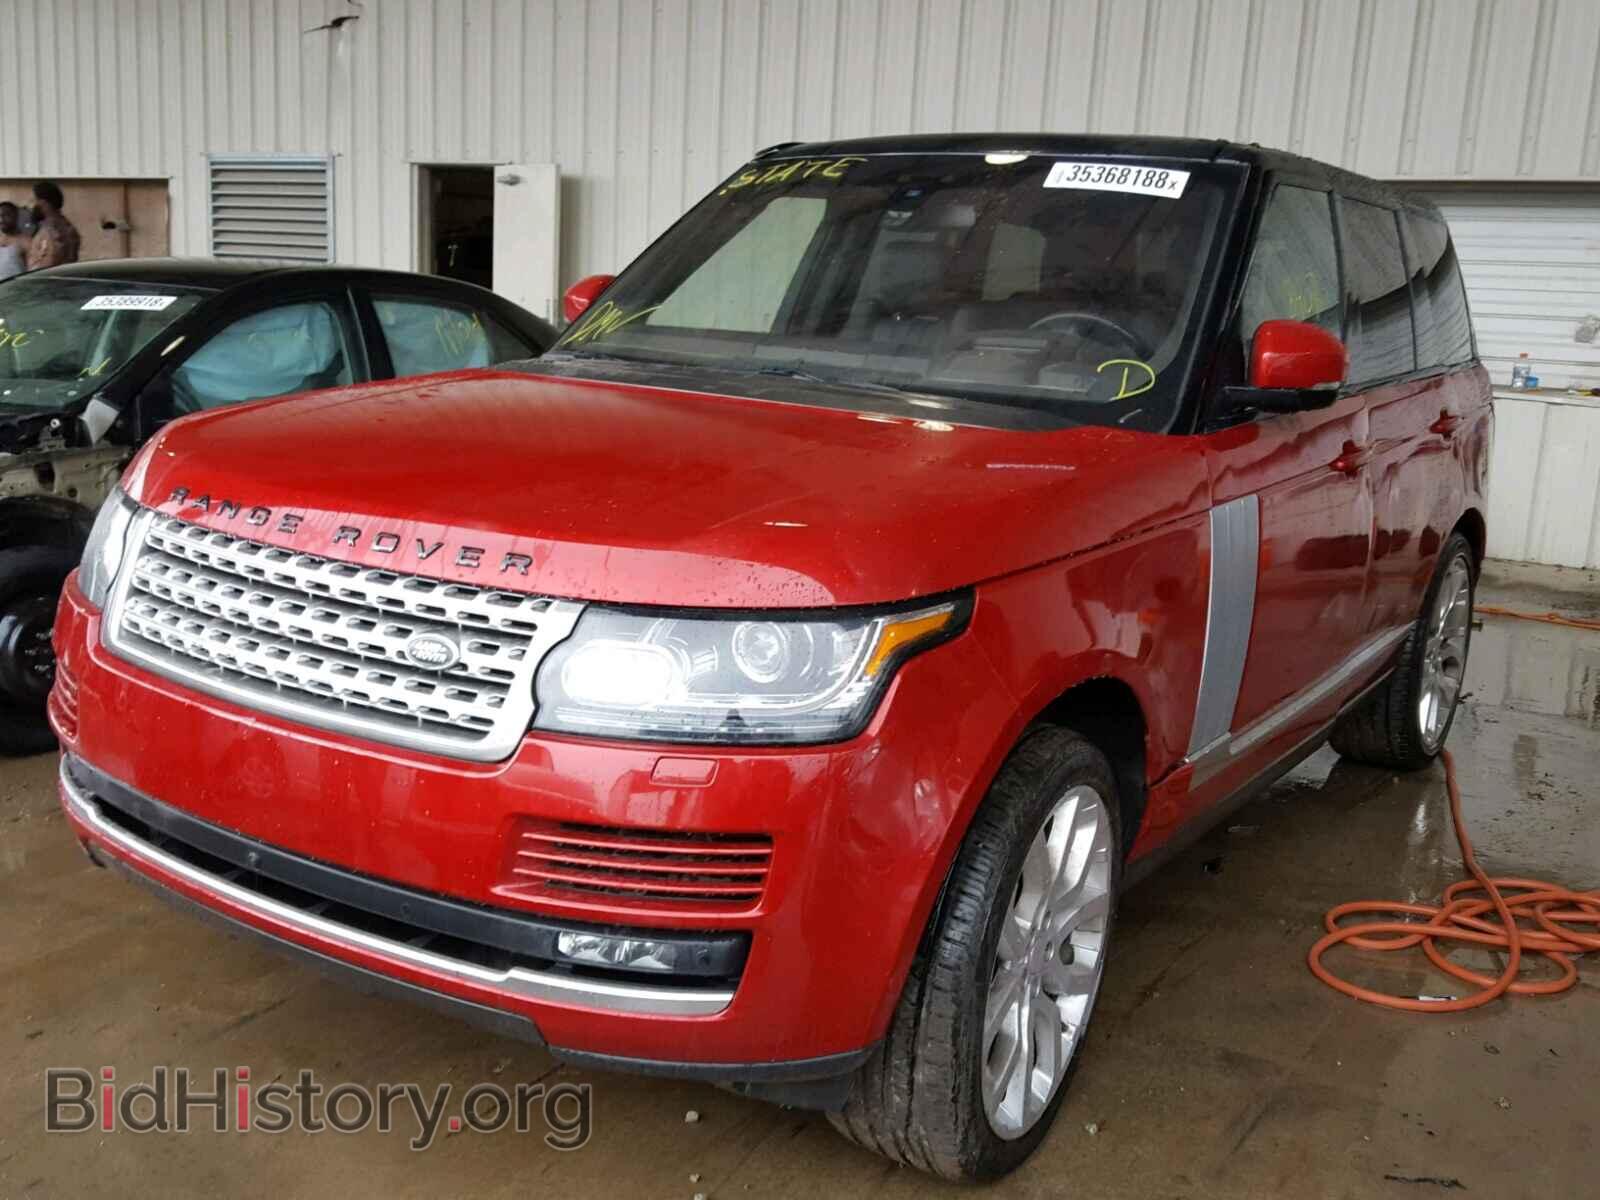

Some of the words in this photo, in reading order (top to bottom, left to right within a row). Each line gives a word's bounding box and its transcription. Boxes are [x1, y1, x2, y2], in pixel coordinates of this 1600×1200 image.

[1096, 358, 1156, 401] D
[169, 486, 303, 534] RANGE
[332, 525, 534, 576] ROVER
